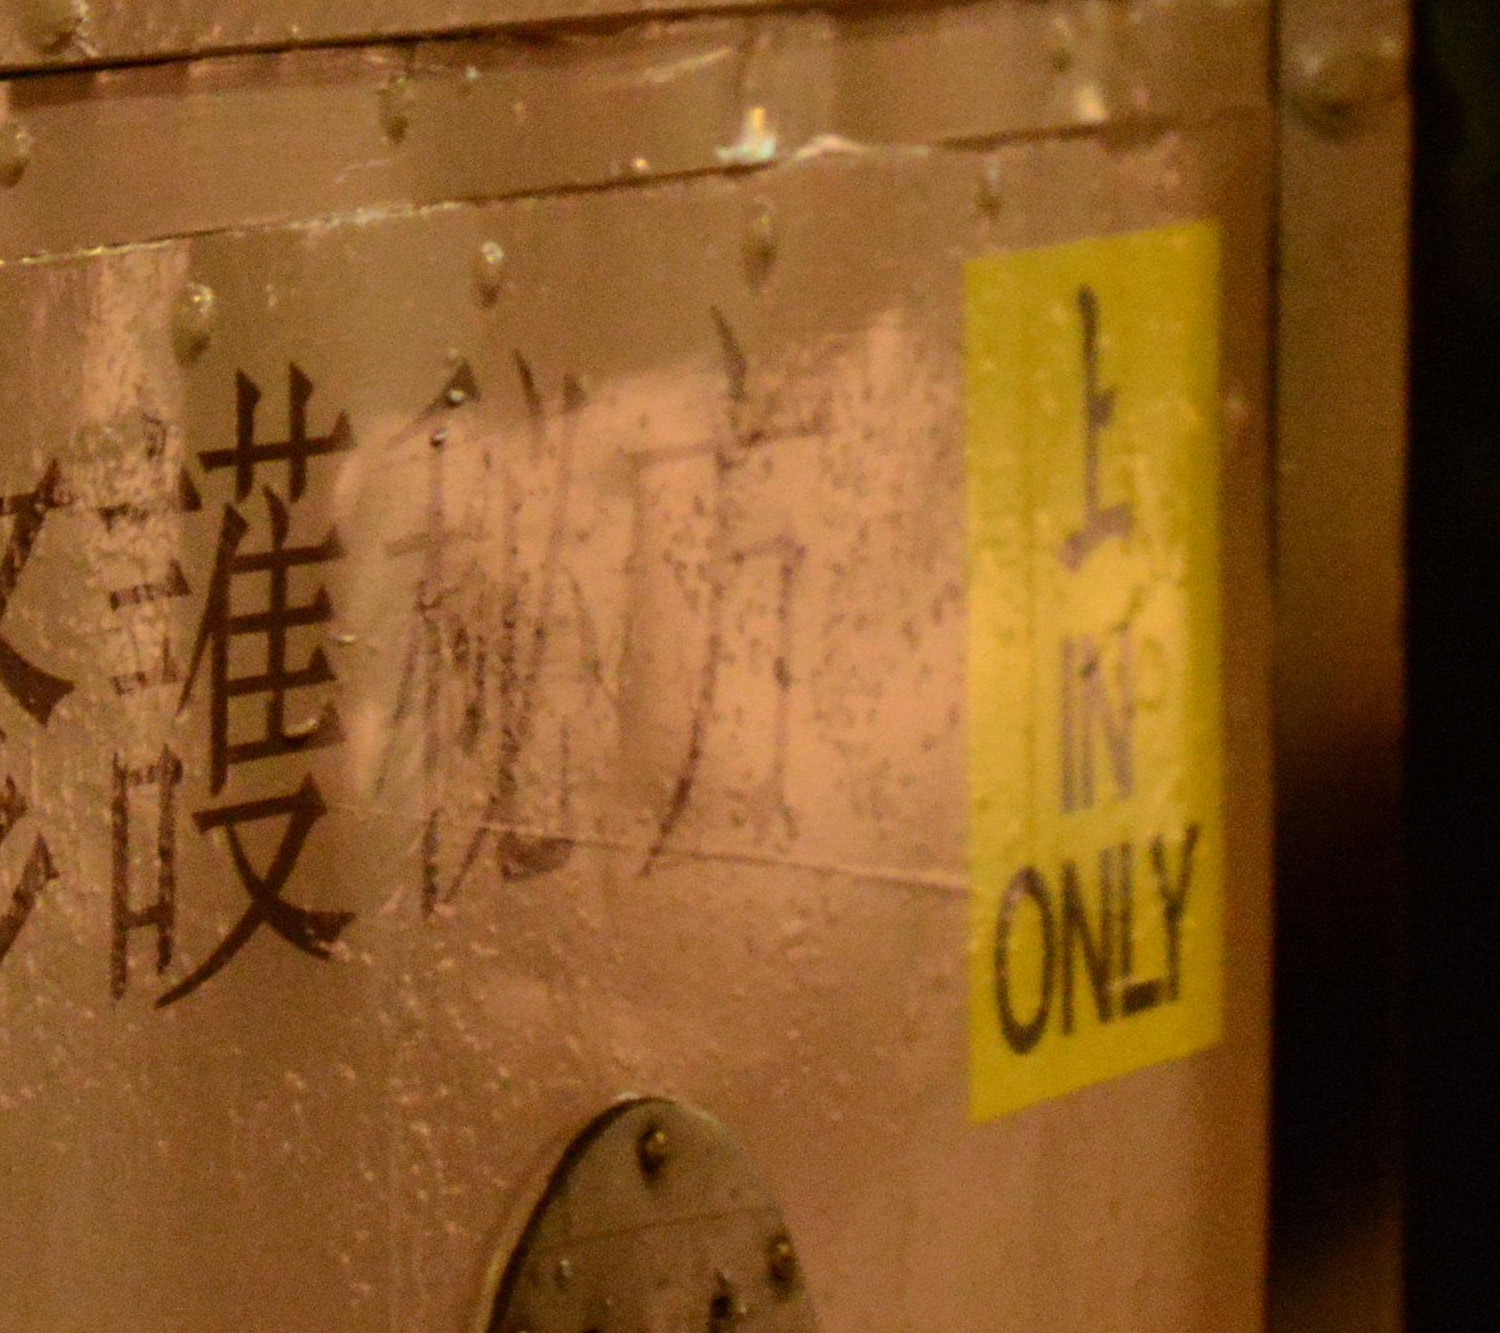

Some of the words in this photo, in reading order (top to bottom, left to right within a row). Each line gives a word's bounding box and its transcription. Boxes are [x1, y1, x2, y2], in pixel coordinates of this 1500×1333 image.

[1061, 282, 1138, 571] 上
[1058, 629, 1137, 813] IN
[992, 822, 1202, 1057] ONLY
